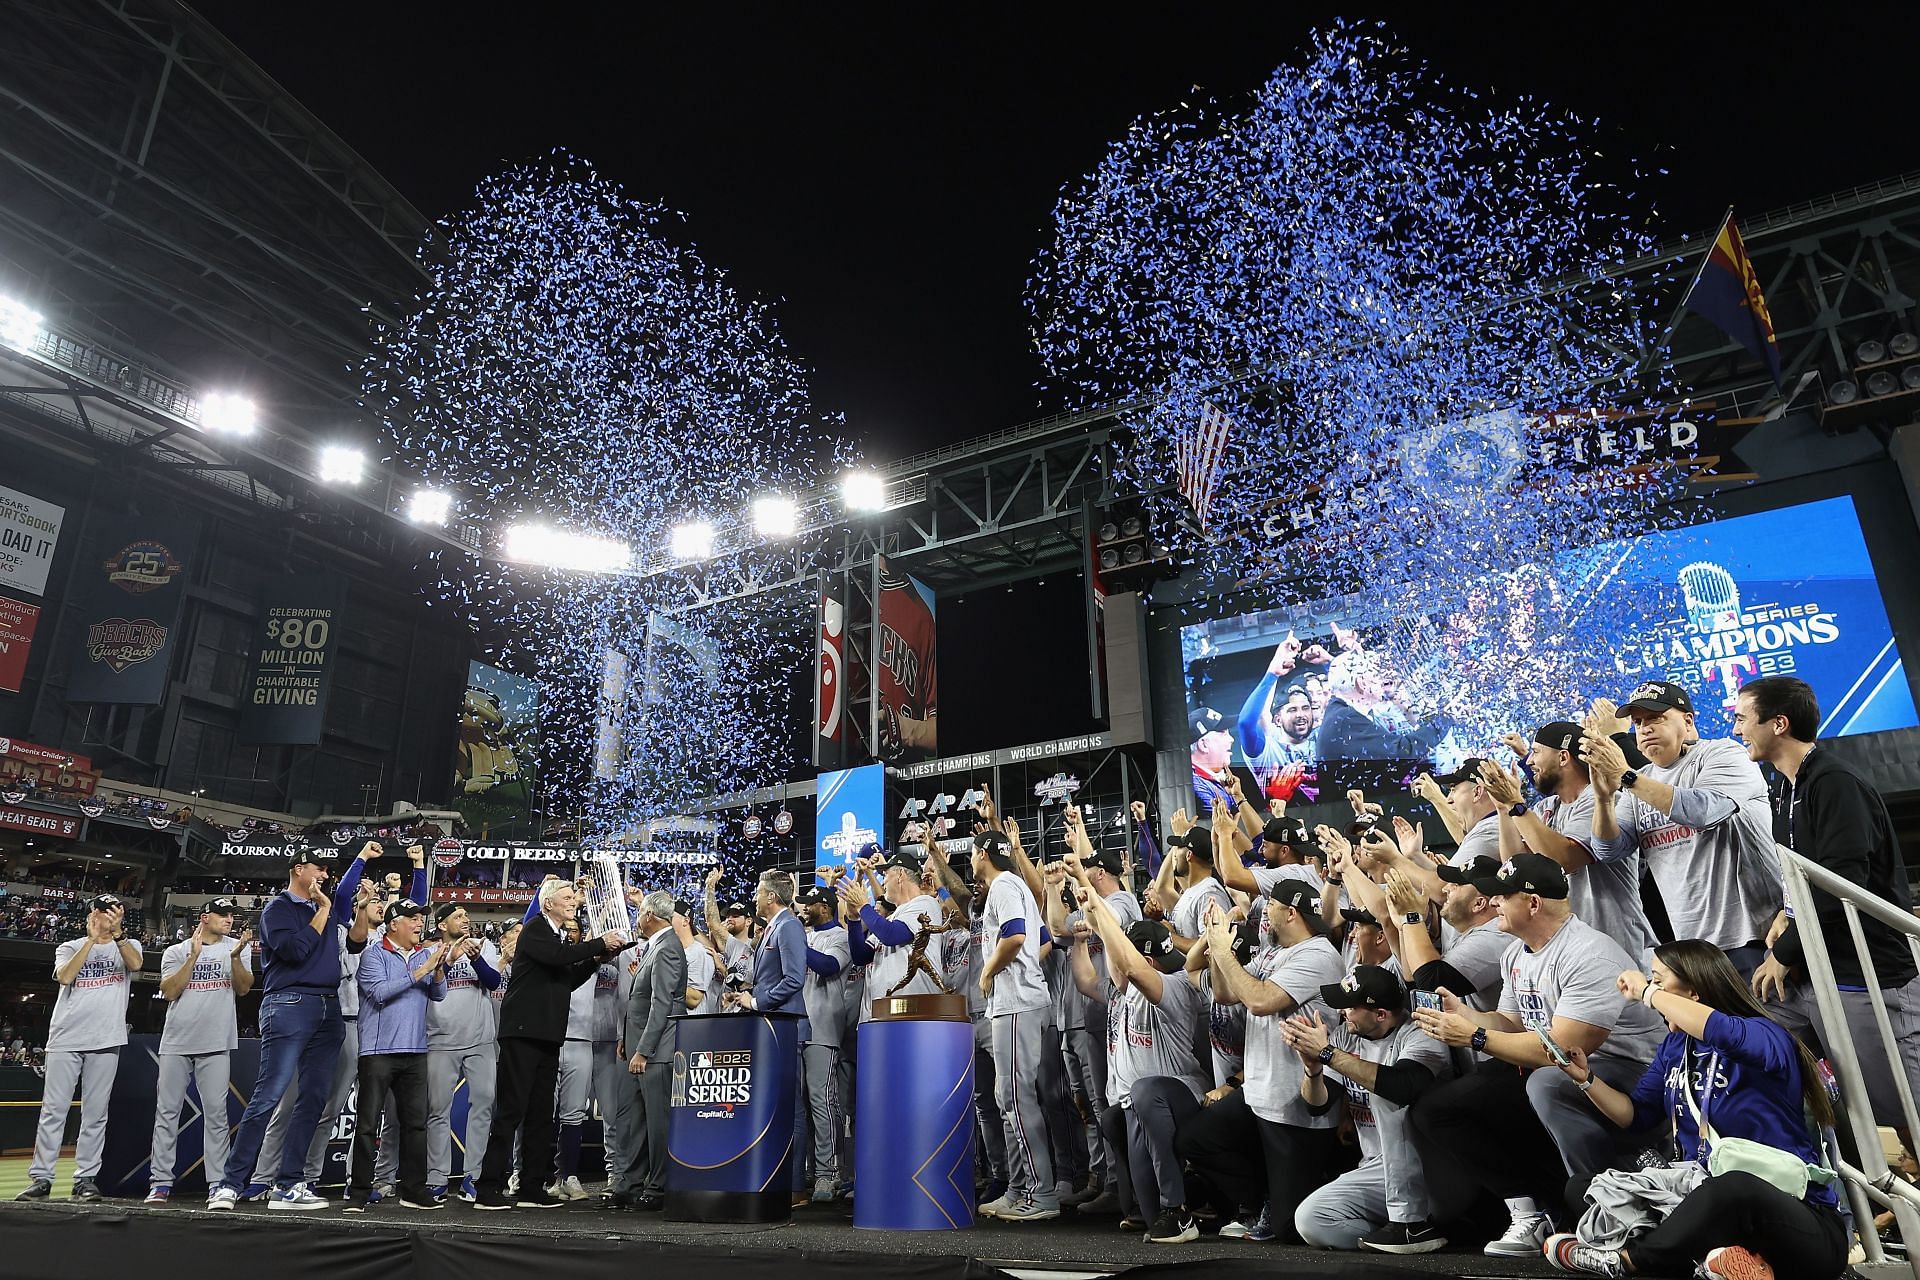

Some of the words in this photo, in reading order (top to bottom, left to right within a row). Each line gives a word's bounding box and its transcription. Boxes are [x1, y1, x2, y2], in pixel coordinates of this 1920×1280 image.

[1541, 421, 1698, 463] FIELD
[36, 539, 52, 559] IT
[125, 551, 161, 575] 25
[269, 607, 332, 618] CELEBRATING
[1740, 603, 1820, 626] SERIES
[266, 617, 329, 649] $80
[1614, 613, 1840, 675] CHAMPIONS
[92, 643, 121, 660] Give
[116, 644, 155, 661] Back
[260, 650, 325, 665] MILLION
[284, 665, 296, 675] IN
[1758, 654, 1796, 673] 23
[256, 676, 320, 687] CHARITABLE
[253, 688, 318, 706] GIVING
[12, 745, 40, 755] Phoenix
[41, 750, 72, 761] Childre
[1011, 747, 1043, 760] WORLD
[1045, 736, 1103, 755] CHAMPIONS
[896, 768, 908, 778] NL
[910, 763, 935, 776] WEST
[937, 754, 991, 772] CHAMPIONS
[26, 815, 58, 830] SEATS
[63, 825, 72, 834] S
[284, 844, 296, 857] &
[466, 847, 510, 859] COLD
[513, 848, 567, 861] BEERS
[569, 850, 580, 862] &
[870, 843, 880, 853] T
[43, 888, 75, 899] BAR-S
[480, 890, 500, 900] Your
[76, 975, 125, 988] CHAMPIONS
[192, 971, 221, 981] ERIES
[446, 970, 469, 980] RIES
[713, 1054, 751, 1064] 2023
[689, 1068, 751, 1085] WORLD
[688, 1085, 752, 1104] SERIES
